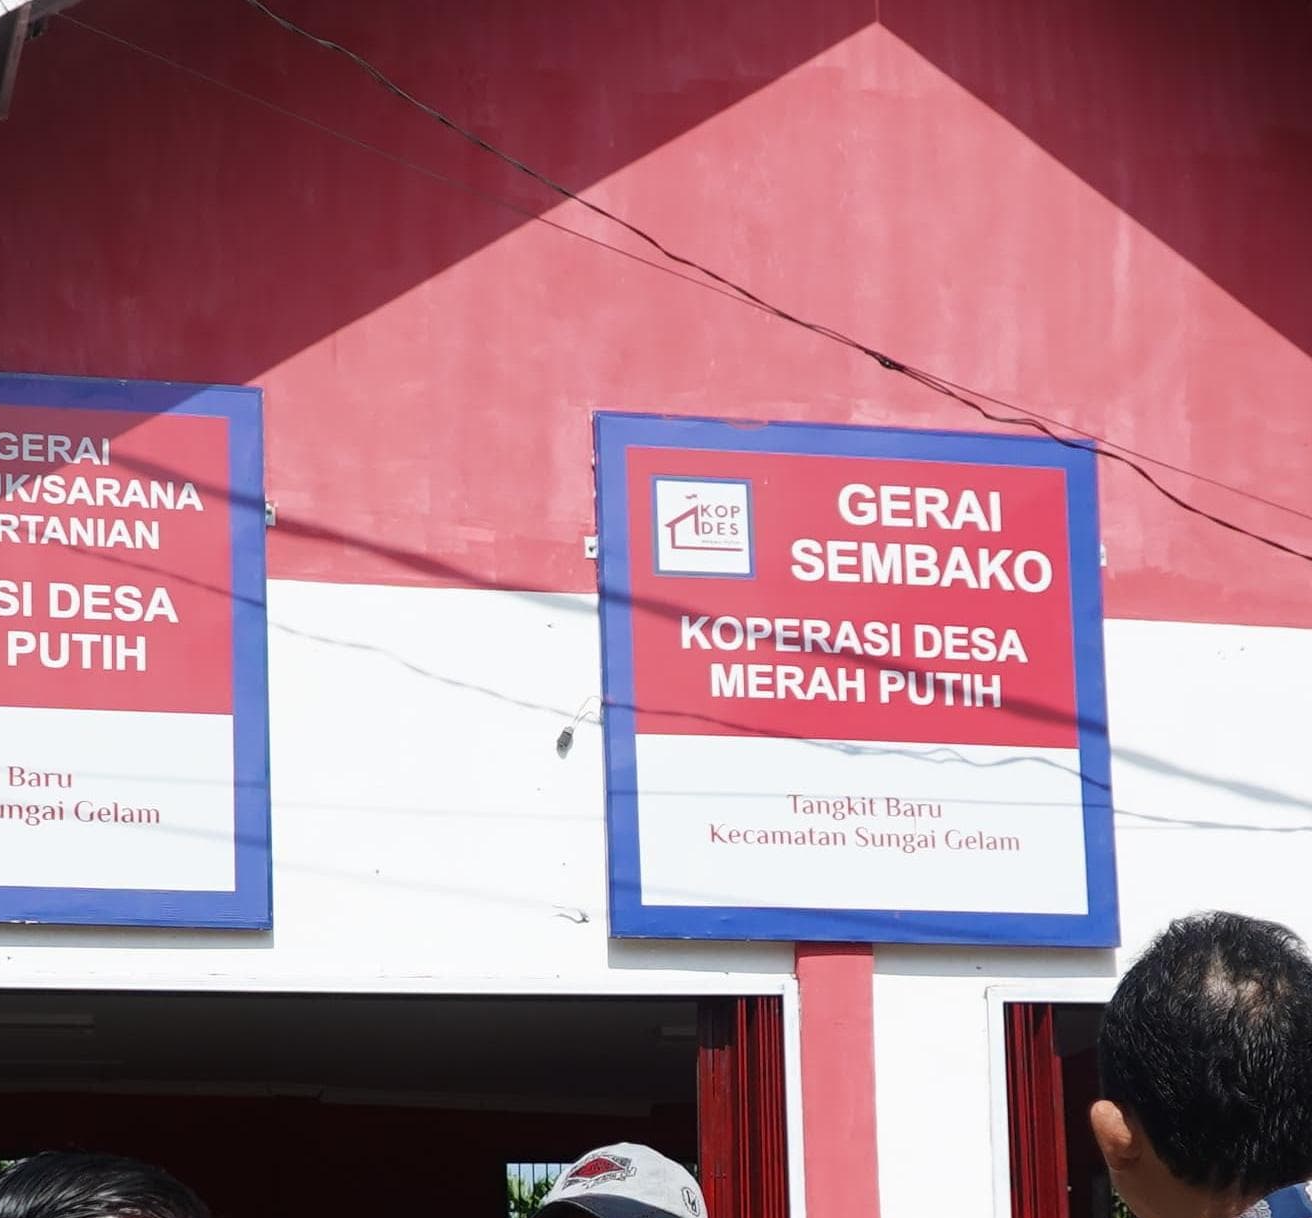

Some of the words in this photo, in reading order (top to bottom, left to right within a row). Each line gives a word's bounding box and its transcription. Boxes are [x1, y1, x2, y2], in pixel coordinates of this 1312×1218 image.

[701, 504, 741, 518] KOP
[838, 484, 1001, 532] GERAI
[702, 521, 739, 535] DES
[792, 539, 1052, 593] SEMBAKO
[49, 583, 178, 623] DESA
[8, 633, 147, 672] PUTIH
[681, 615, 900, 656] KOPERASI
[914, 625, 1028, 663] DESA
[711, 664, 864, 701] MERAH
[879, 671, 1001, 708] PUTIH
[8, 765, 72, 789] Baru
[74, 800, 161, 825] Gelam
[787, 794, 876, 820] Tangkit
[887, 797, 942, 819] Baru
[709, 824, 846, 847] Kecamatan
[856, 828, 936, 853] Sungai
[945, 829, 1020, 851] Gelam
